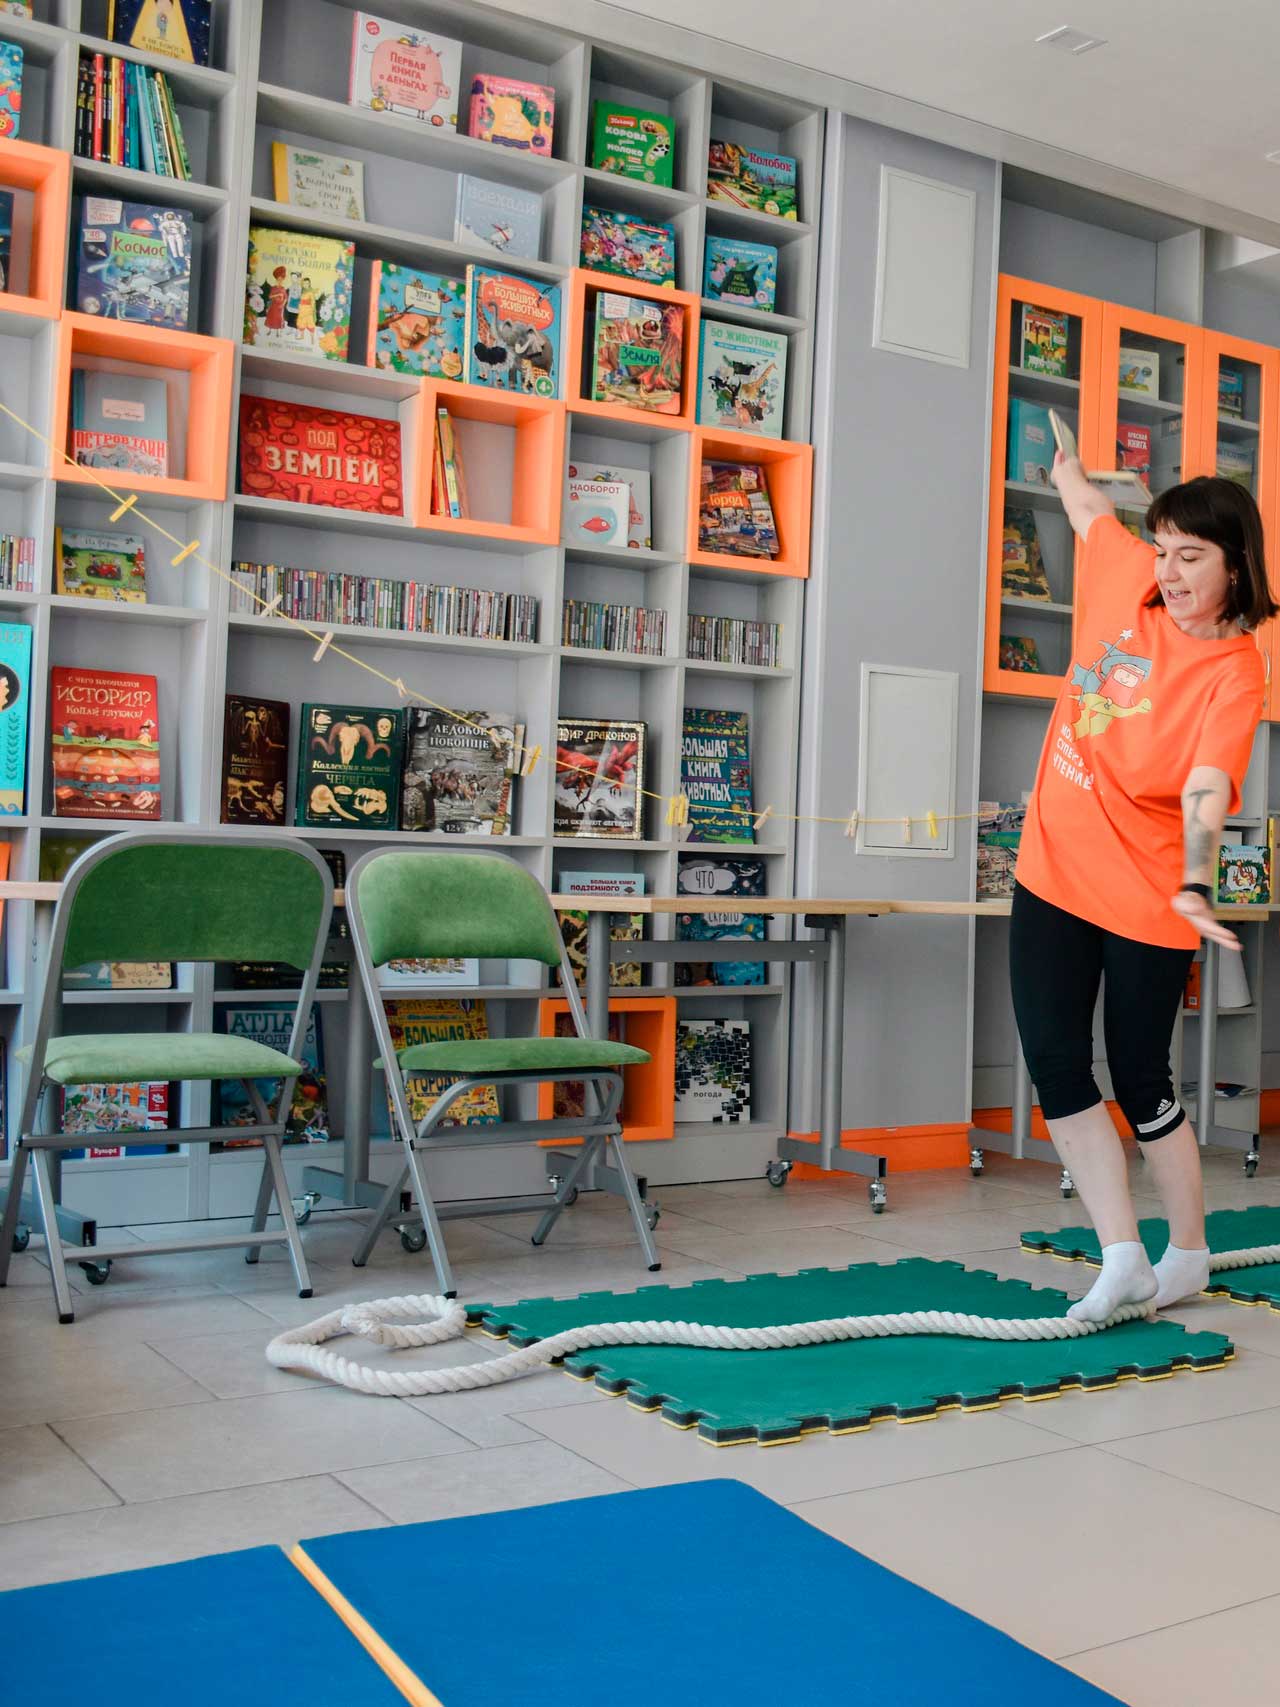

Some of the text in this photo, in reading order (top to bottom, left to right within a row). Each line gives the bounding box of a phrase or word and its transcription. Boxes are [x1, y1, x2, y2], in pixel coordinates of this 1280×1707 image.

[605, 126, 648, 142] КОРОВА
[607, 143, 643, 157] МОЛОКО
[748, 152, 792, 172] Колобок
[495, 287, 537, 307] БОЛЬШИХ
[500, 299, 550, 320] ЖИВОТНЫХ
[76, 431, 129, 449] ОСТРОВ
[308, 429, 336, 448] ПОД
[1127, 439, 1147, 450] КНИГА
[265, 445, 380, 487] ЗЕМЛЁЙ
[569, 483, 620, 494] НАОБОРОТ
[56, 685, 152, 708] ИСТОРИЯ?
[430, 737, 489, 750] ПОБОИЩЕ
[586, 731, 636, 743] ДРАКОНОВ
[687, 761, 722, 778] КНИГА
[570, 884, 620, 892] ПОДЗЕМНОГО
[696, 870, 715, 889] ЧТО
[693, 1090, 722, 1098] погода
